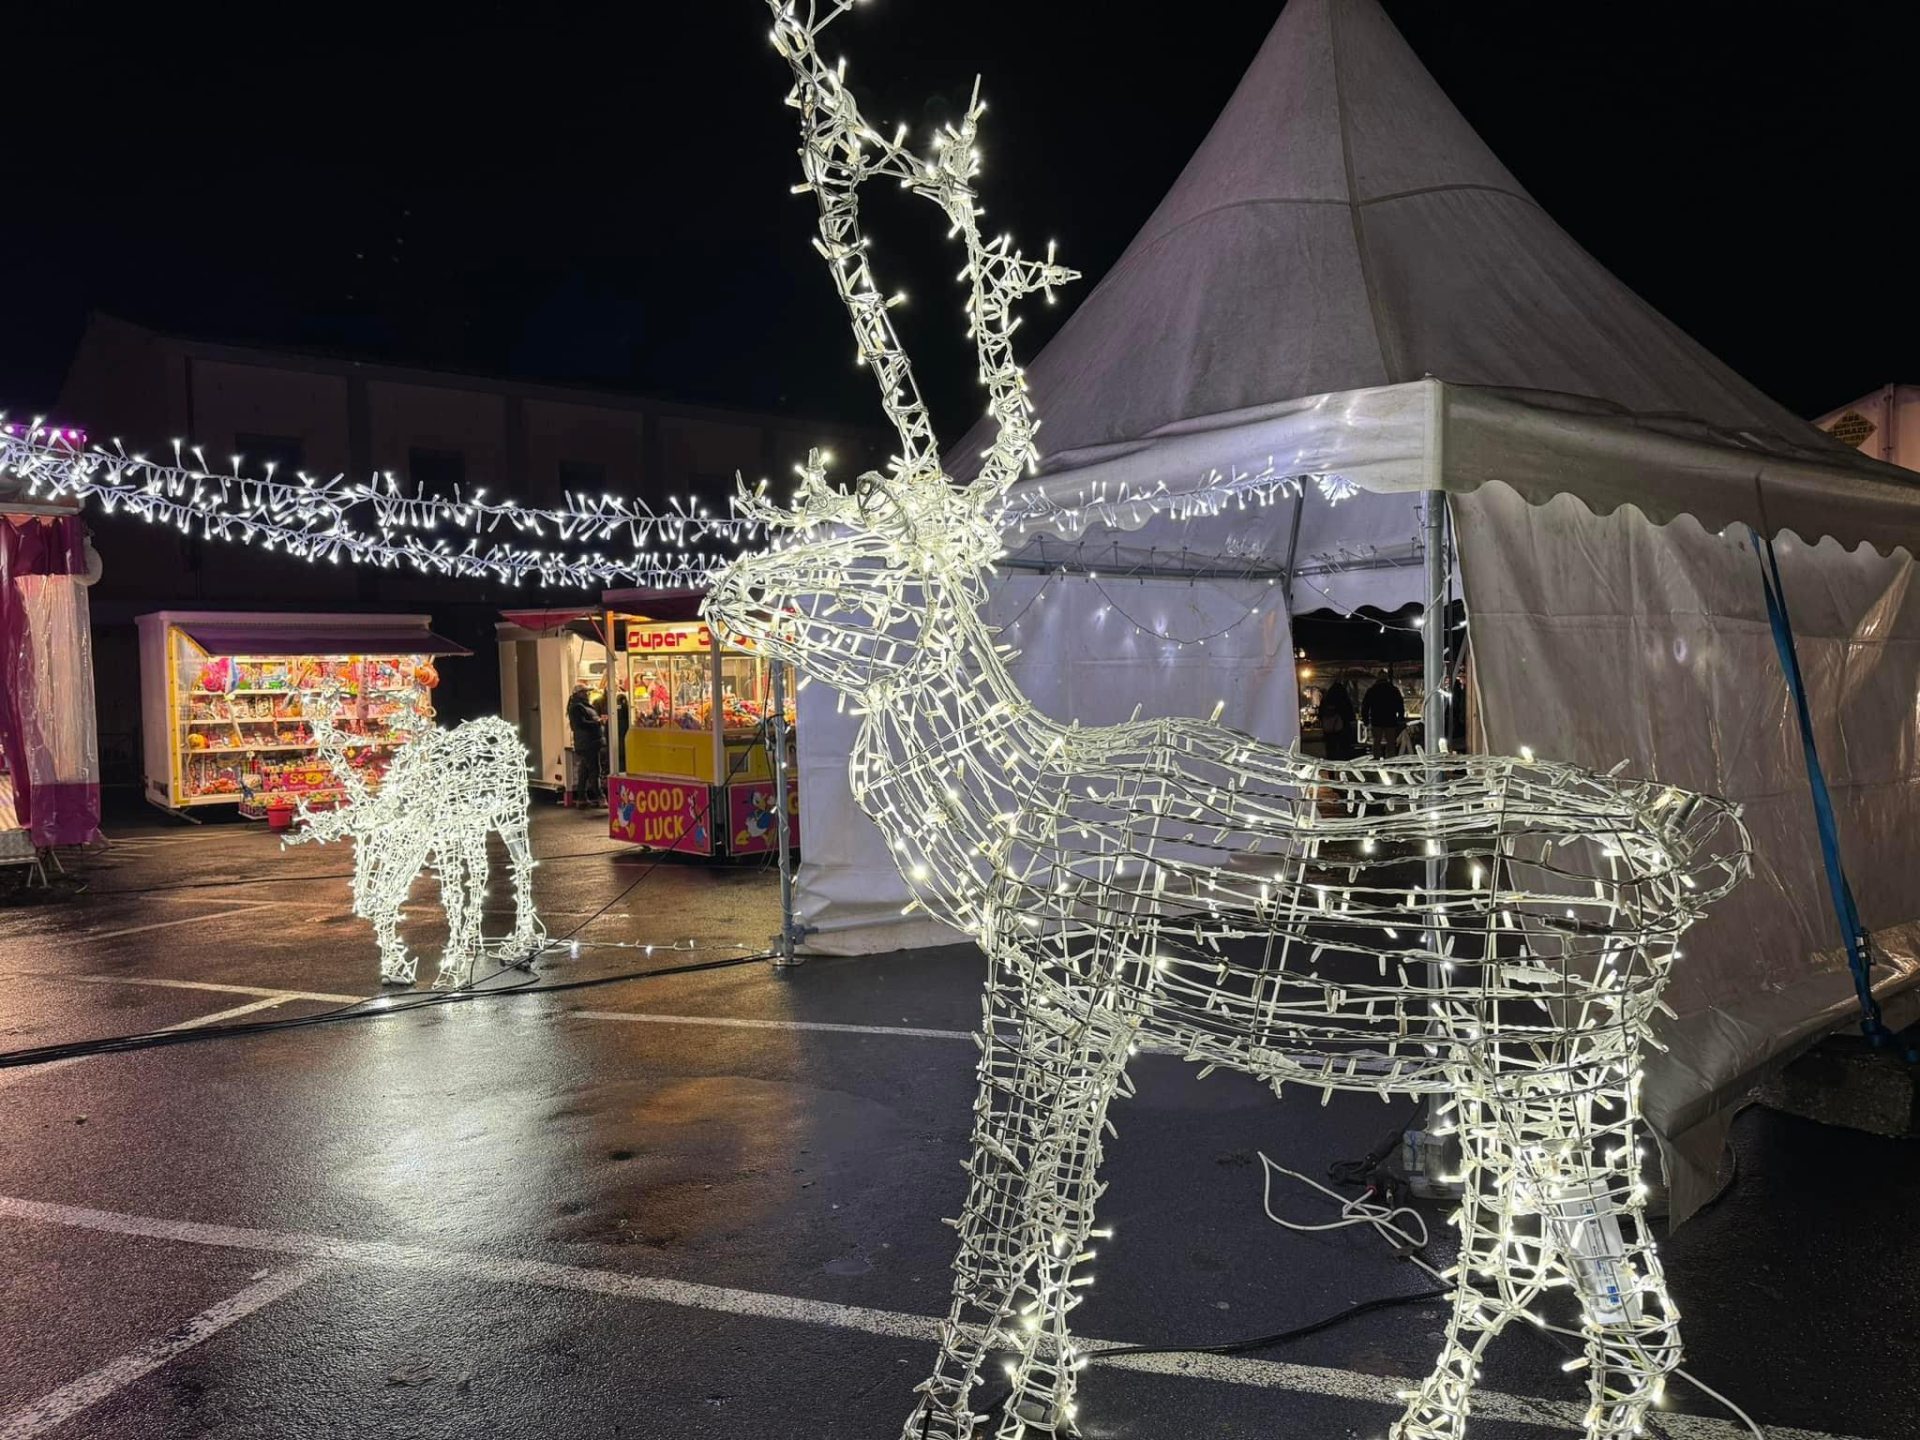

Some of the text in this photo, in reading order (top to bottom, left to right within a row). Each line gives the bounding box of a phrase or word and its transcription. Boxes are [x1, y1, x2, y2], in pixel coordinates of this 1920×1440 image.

[628, 631, 687, 650] Super
[636, 787, 684, 814] GOOD
[645, 814, 685, 842] LUCK
